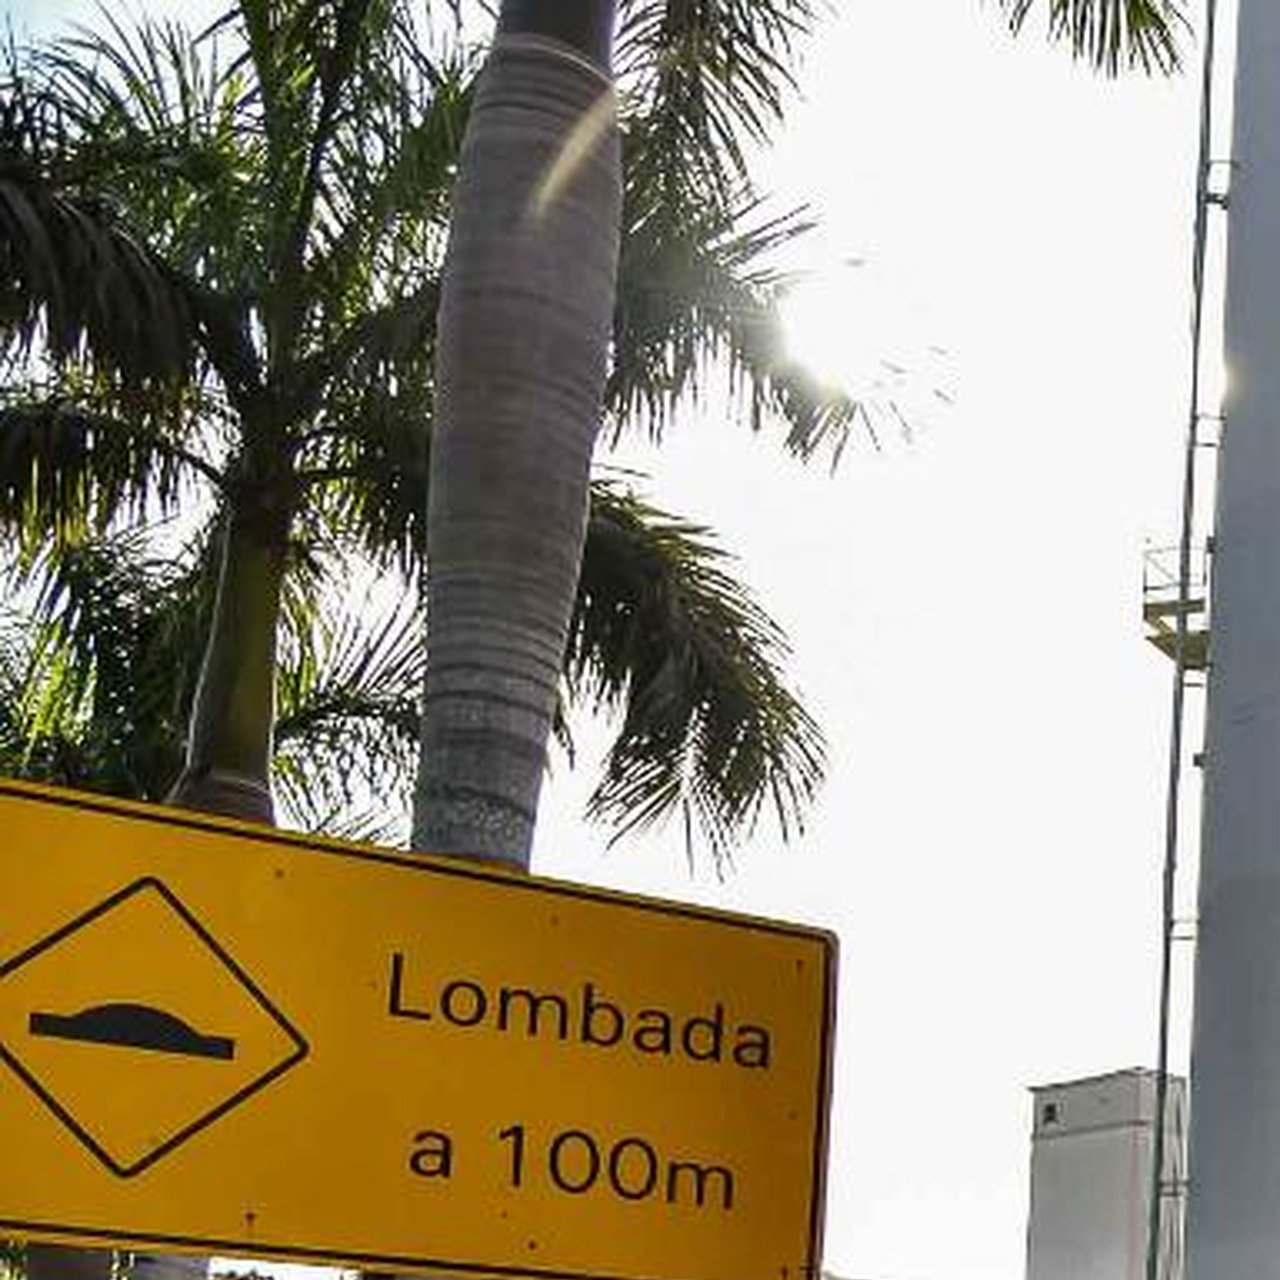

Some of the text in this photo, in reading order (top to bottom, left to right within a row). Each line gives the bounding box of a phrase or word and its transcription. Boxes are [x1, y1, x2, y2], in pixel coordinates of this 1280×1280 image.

[388, 952, 772, 1071] Lombada
[409, 1125, 736, 1211] a 100m
